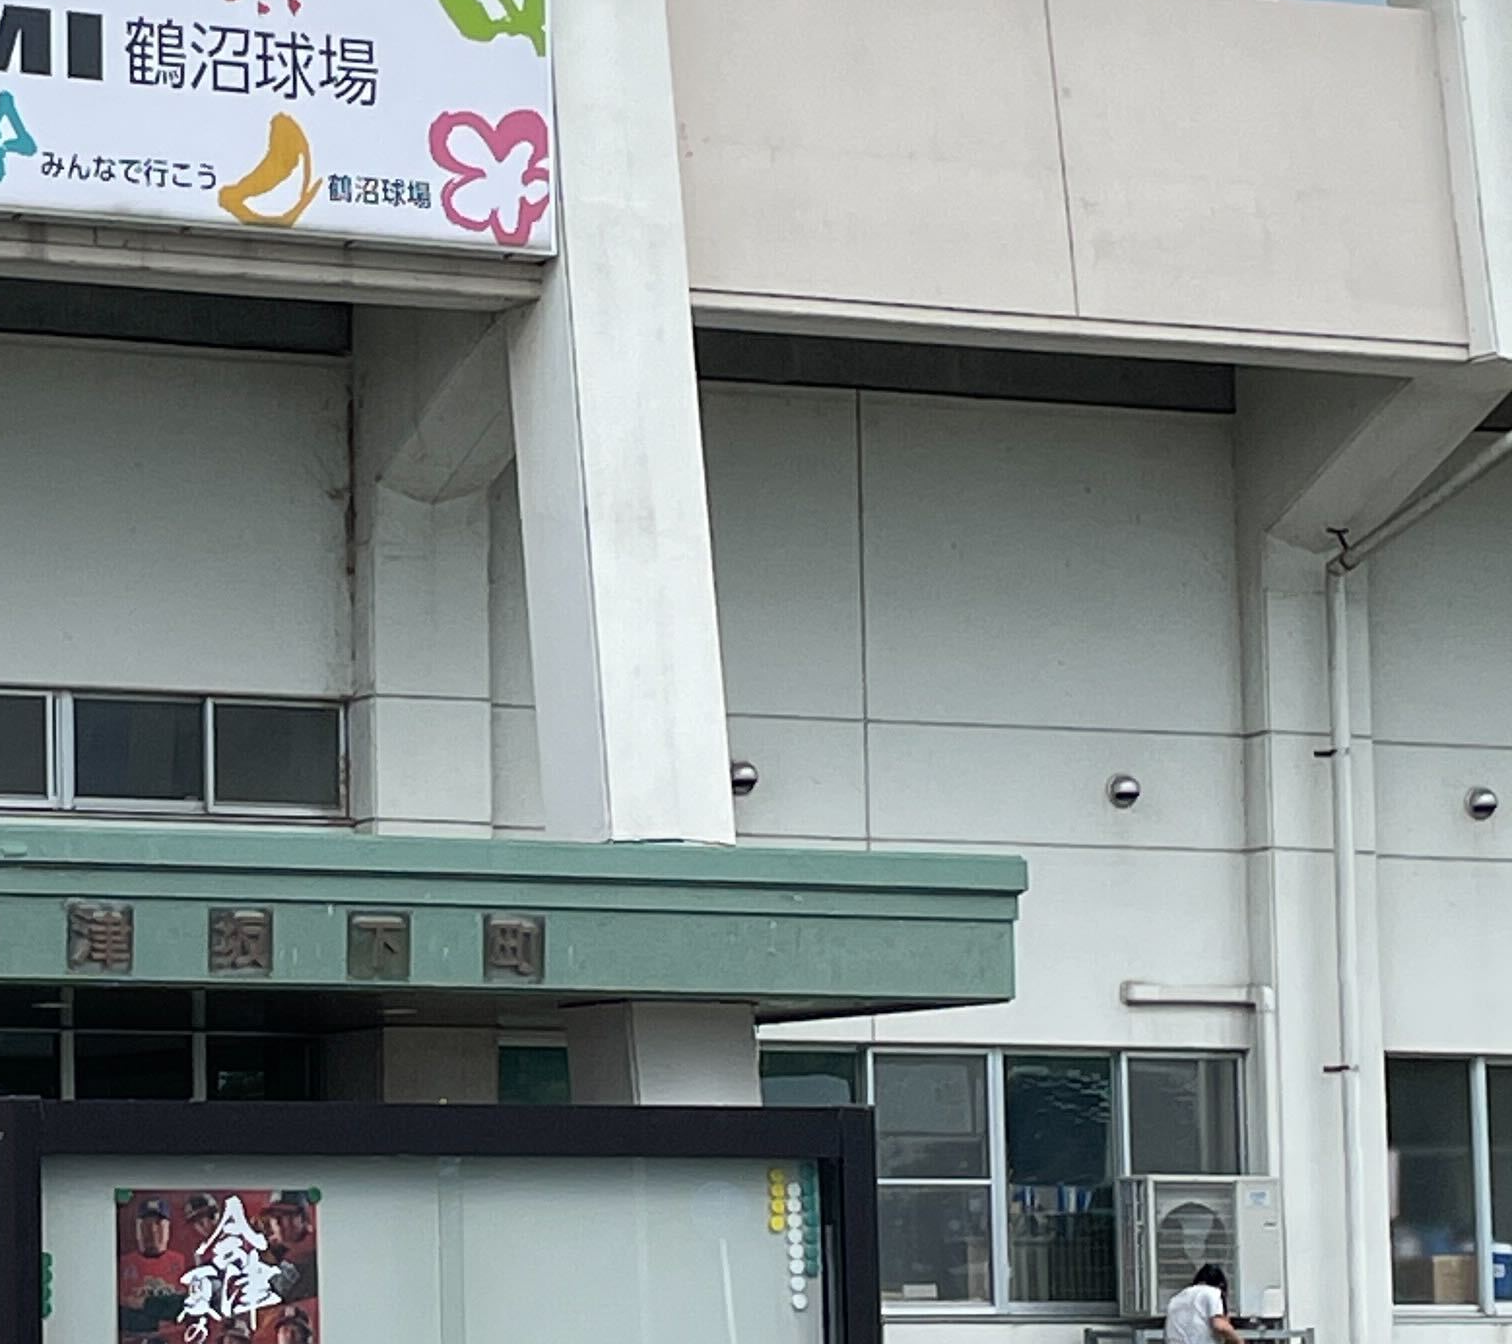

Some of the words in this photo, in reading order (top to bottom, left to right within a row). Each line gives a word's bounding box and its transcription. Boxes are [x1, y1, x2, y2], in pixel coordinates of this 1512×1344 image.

[125, 16, 378, 106] 鶴沼球場
[41, 151, 216, 189] みんなで行こう
[328, 173, 431, 208] 鶴沼球場
